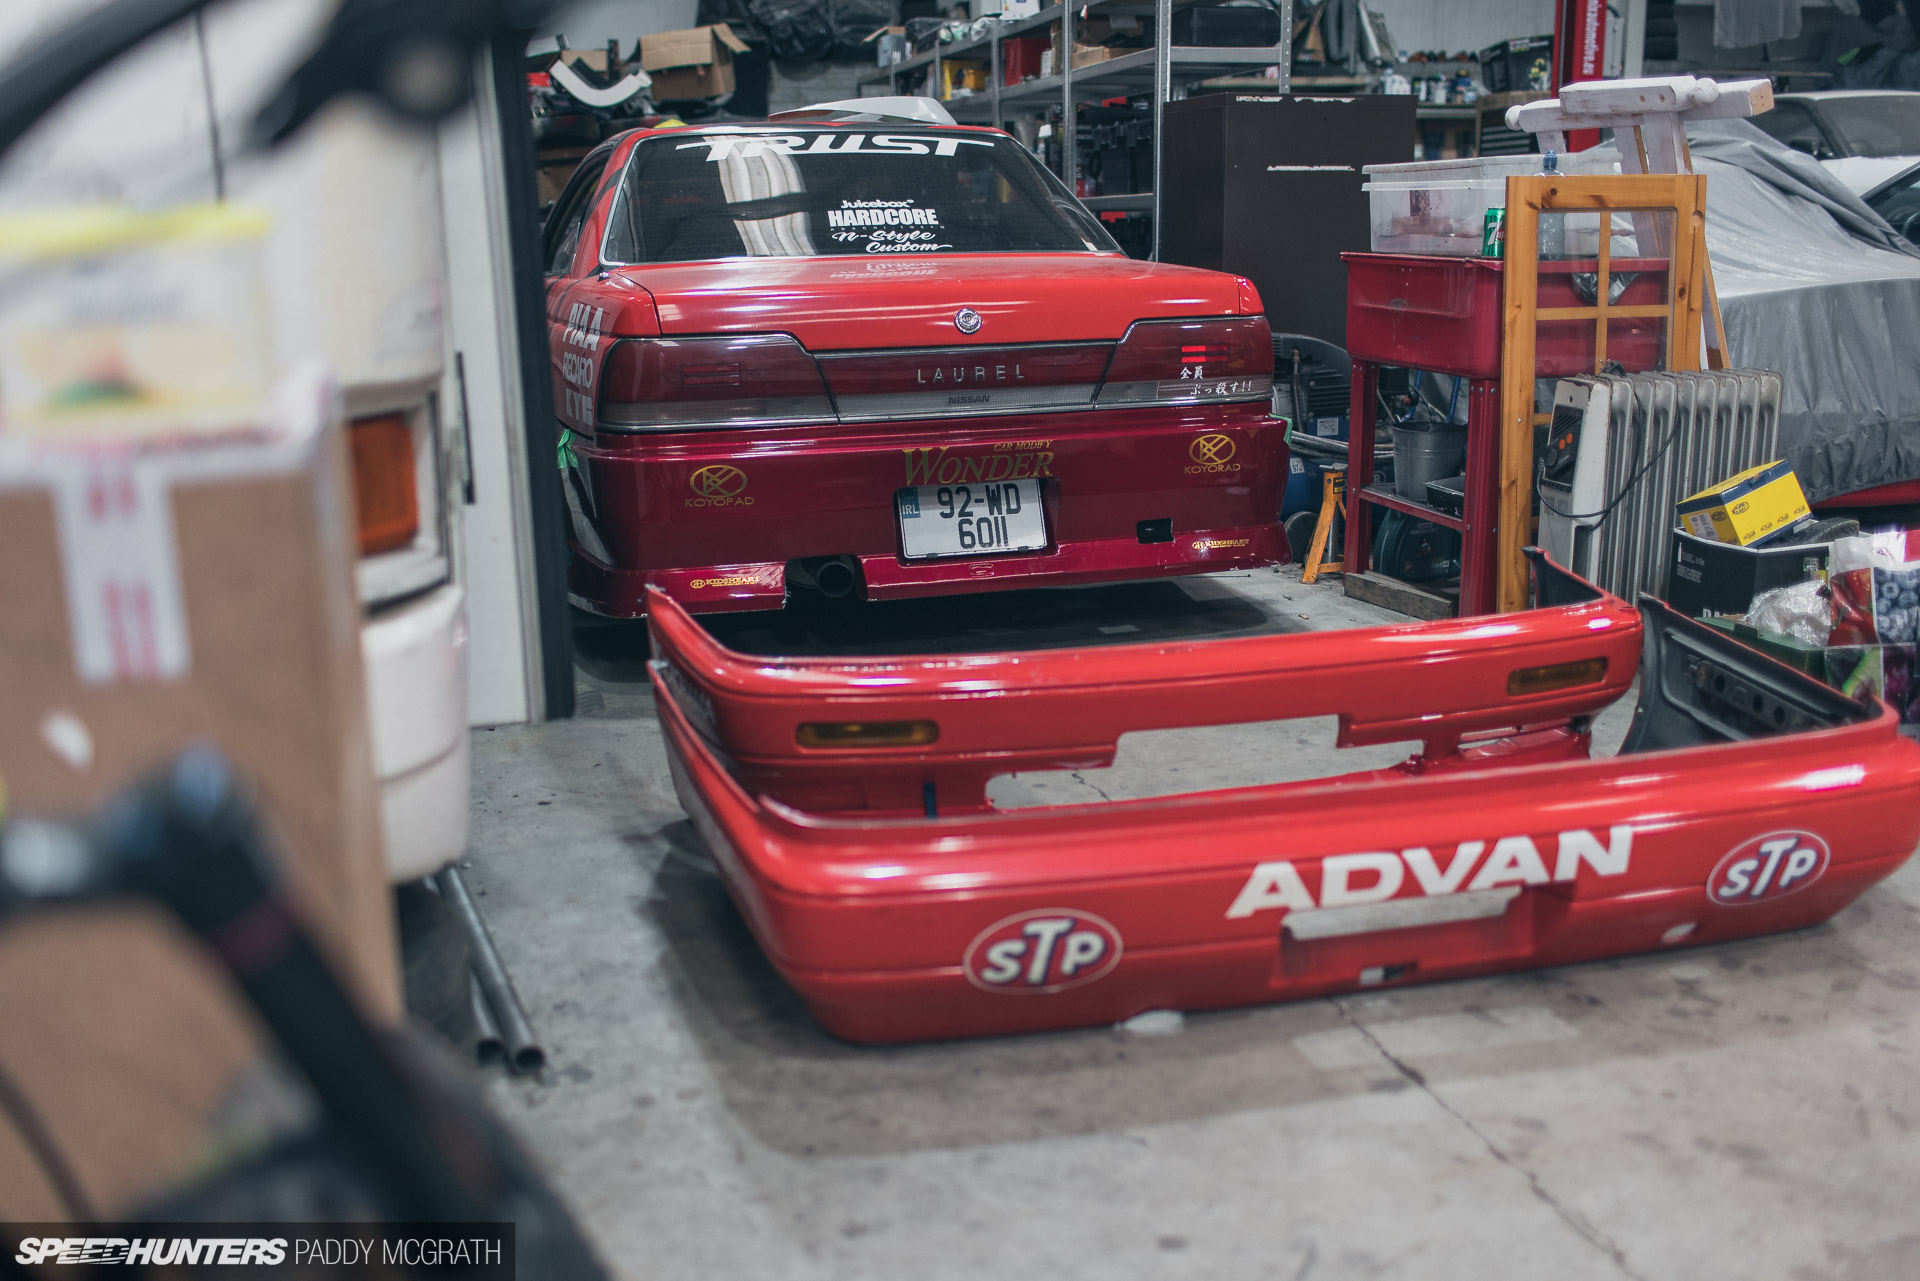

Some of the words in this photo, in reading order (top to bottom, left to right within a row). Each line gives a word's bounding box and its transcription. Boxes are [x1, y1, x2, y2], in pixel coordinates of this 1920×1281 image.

[675, 134, 995, 162] TRUST
[827, 208, 940, 227] HARDCORE
[865, 241, 953, 253] Custom
[562, 302, 604, 352] PIAA
[562, 351, 594, 389] RECARO
[917, 364, 1025, 384] LAUREL
[1180, 365, 1204, 380] 全員
[948, 394, 990, 405] NISSAN
[993, 442, 1013, 451] CAR
[1015, 439, 1053, 451] MODIFY
[1184, 463, 1242, 475] KOYORAD
[902, 504, 920, 515] IRL
[936, 482, 1022, 519] 92-WD
[957, 515, 1010, 550] 6011
[1225, 824, 1634, 919] ADVAN
[1717, 838, 1818, 897] STP
[979, 917, 1107, 986] STP
